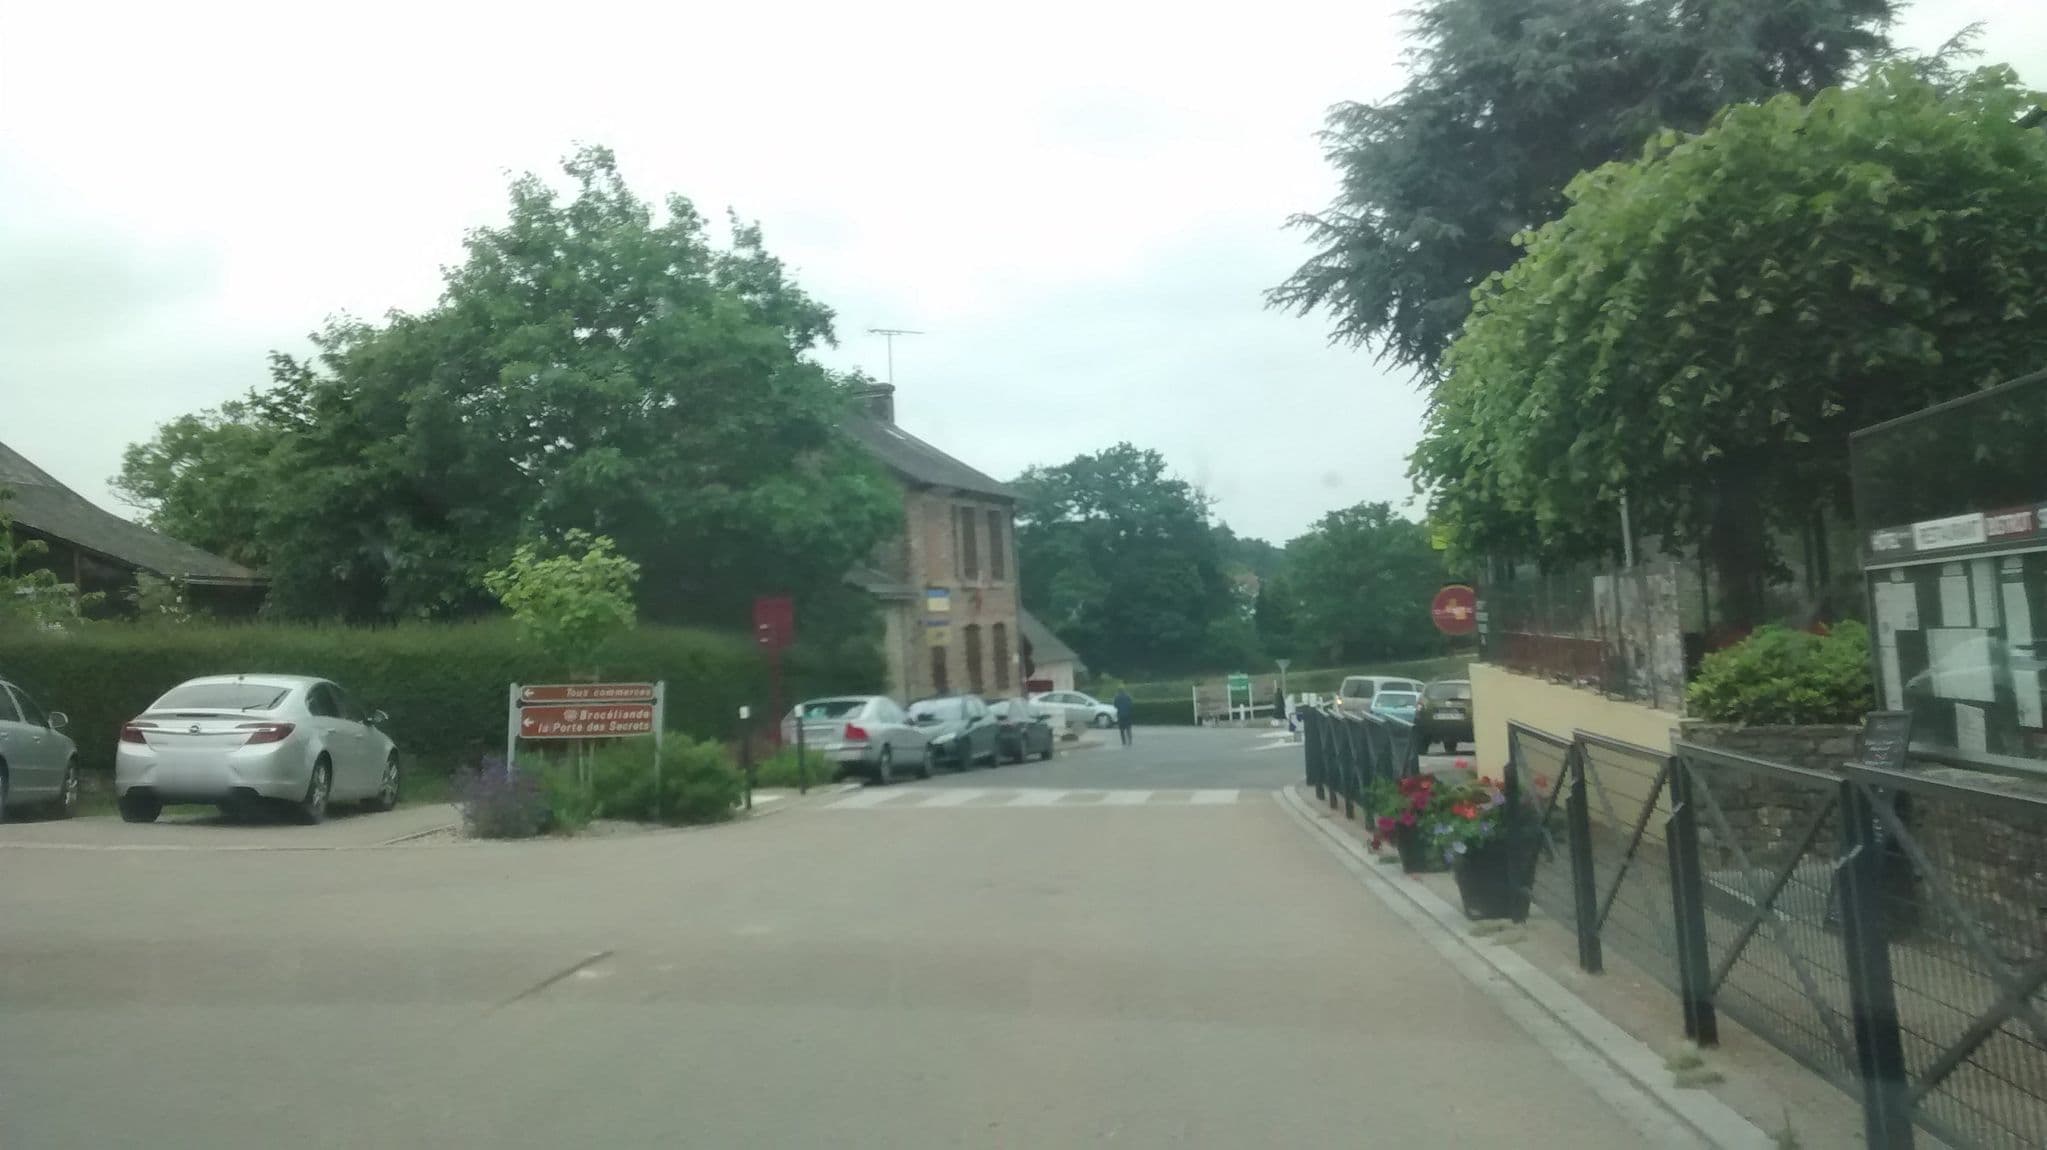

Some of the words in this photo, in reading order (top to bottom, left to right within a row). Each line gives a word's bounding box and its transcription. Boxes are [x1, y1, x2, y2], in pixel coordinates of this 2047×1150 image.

[567, 688, 588, 697] Tous
[593, 688, 650, 697] commerces
[579, 710, 649, 720] Brocéliande
[538, 724, 549, 733] la
[553, 723, 582, 733] Porte
[587, 723, 605, 732] des
[609, 721, 649, 731] Secrets
